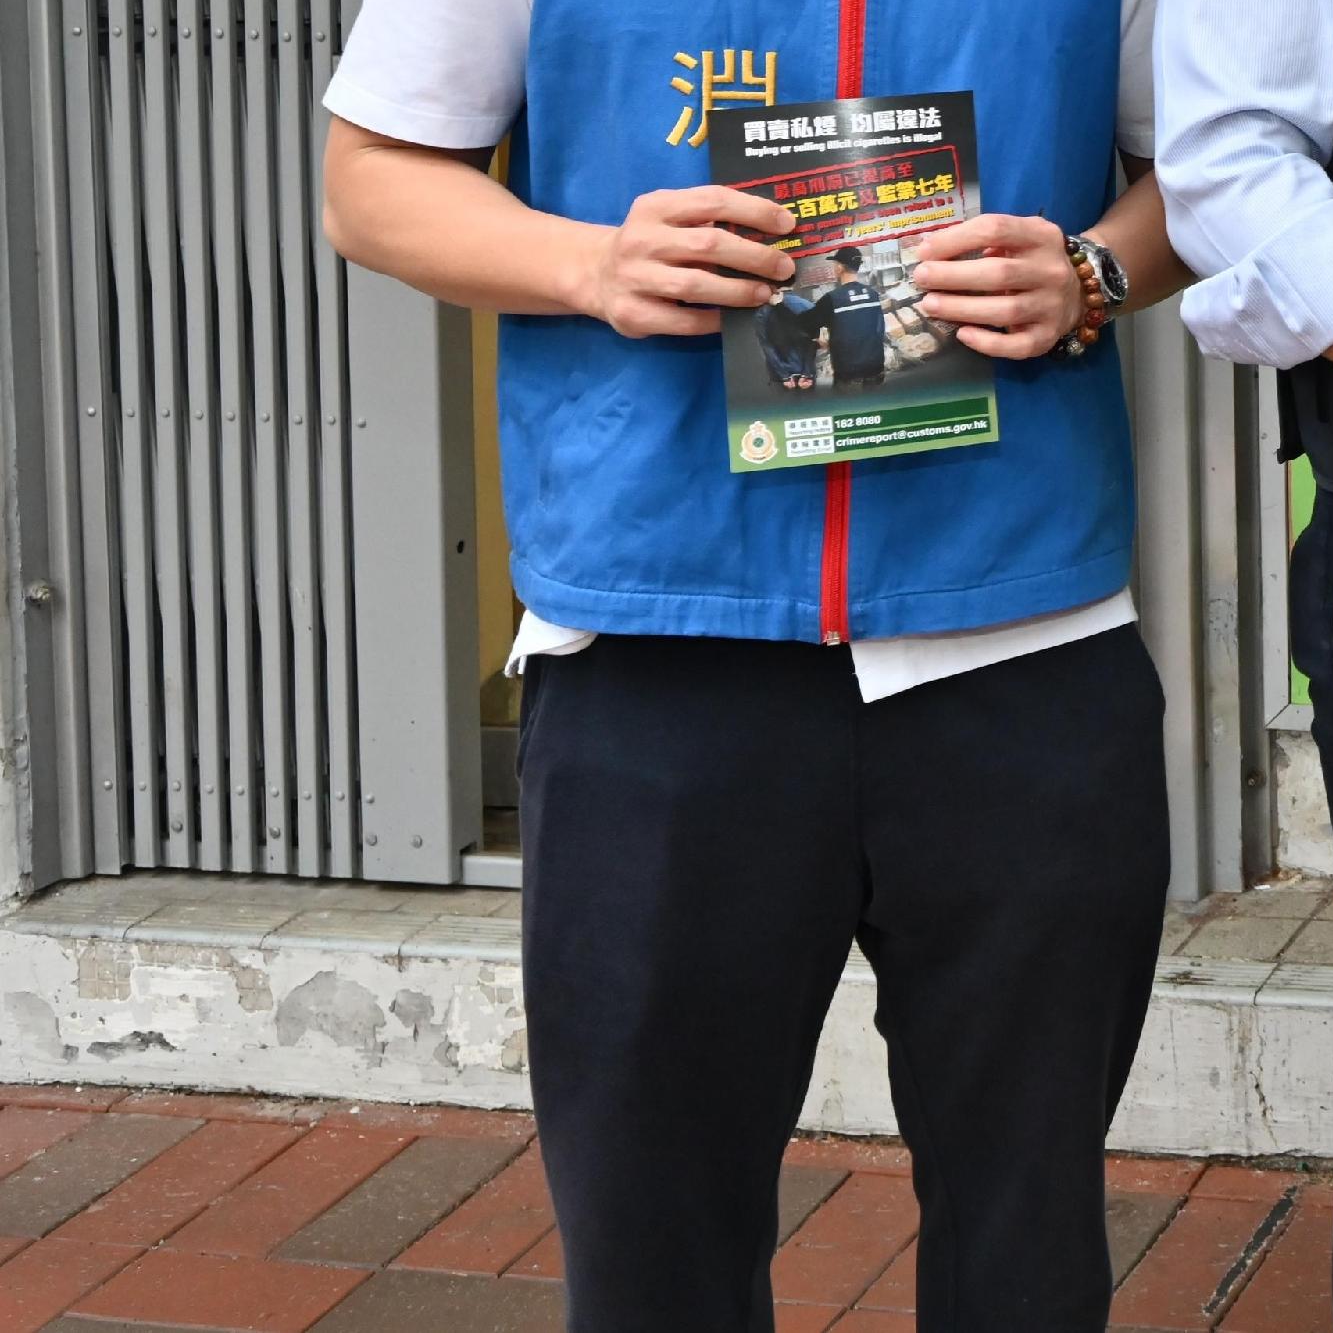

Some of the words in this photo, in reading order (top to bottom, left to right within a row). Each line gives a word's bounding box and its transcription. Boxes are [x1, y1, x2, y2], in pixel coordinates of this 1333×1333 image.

[744, 115, 838, 142] 買賣私煙
[850, 107, 942, 133] 均屬違法
[745, 146, 779, 158] Buying
[854, 136, 901, 148] cigarettes
[914, 132, 942, 143] illegal
[834, 419, 853, 429] 182
[856, 415, 881, 426] 8080
[835, 419, 988, 447] crimereport@customs.gov.hk
